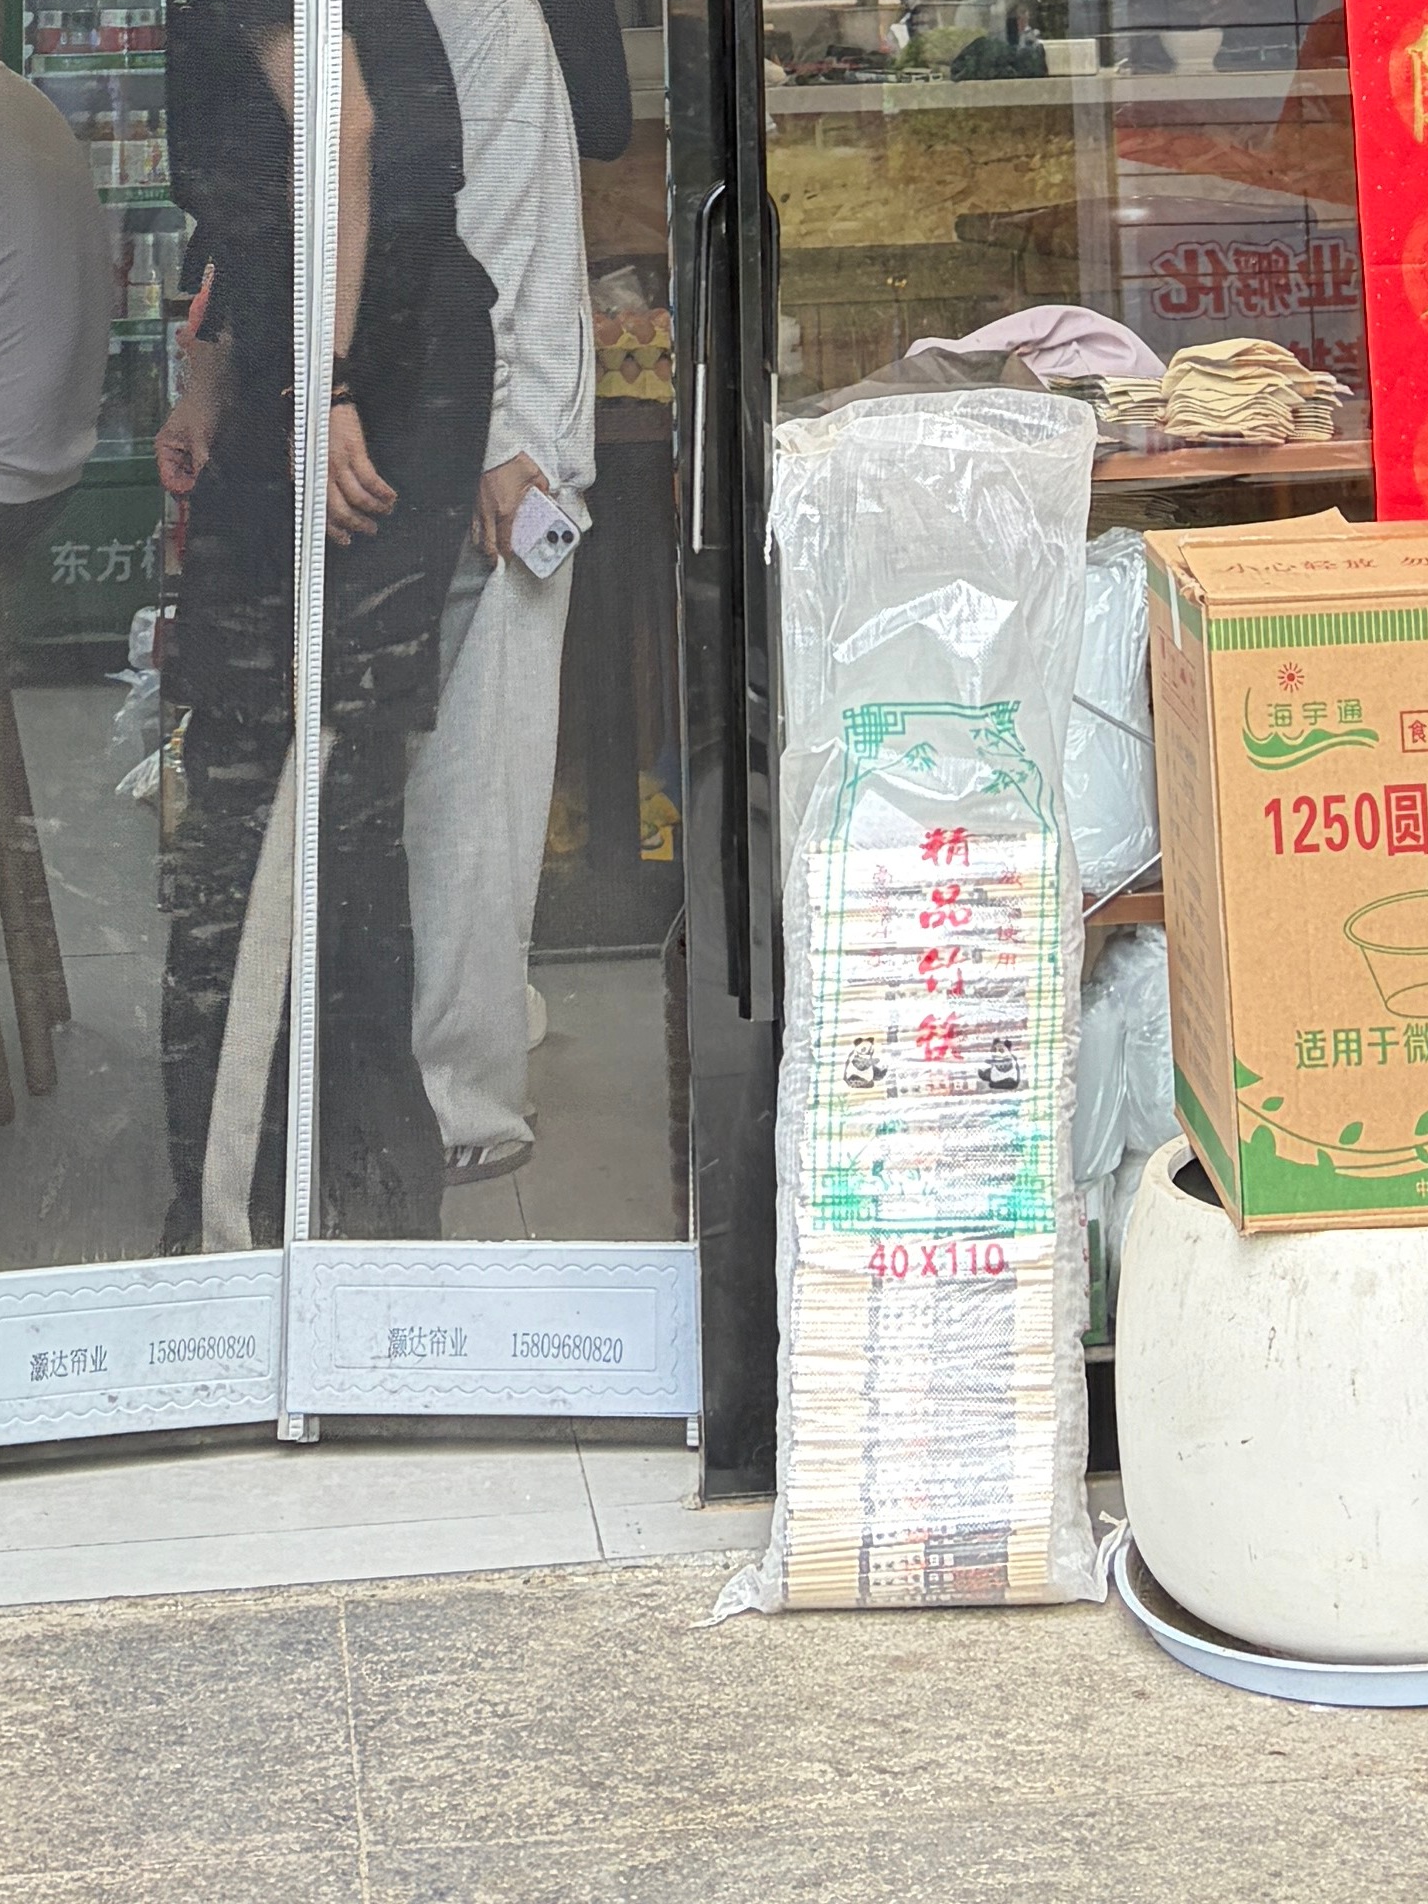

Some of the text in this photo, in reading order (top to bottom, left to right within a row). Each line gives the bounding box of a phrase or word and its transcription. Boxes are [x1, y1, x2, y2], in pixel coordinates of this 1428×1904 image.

[1267, 699, 1362, 728] 海宇通
[148, 1335, 256, 1365] 15809680820
[512, 1332, 623, 1364] 15809680820
